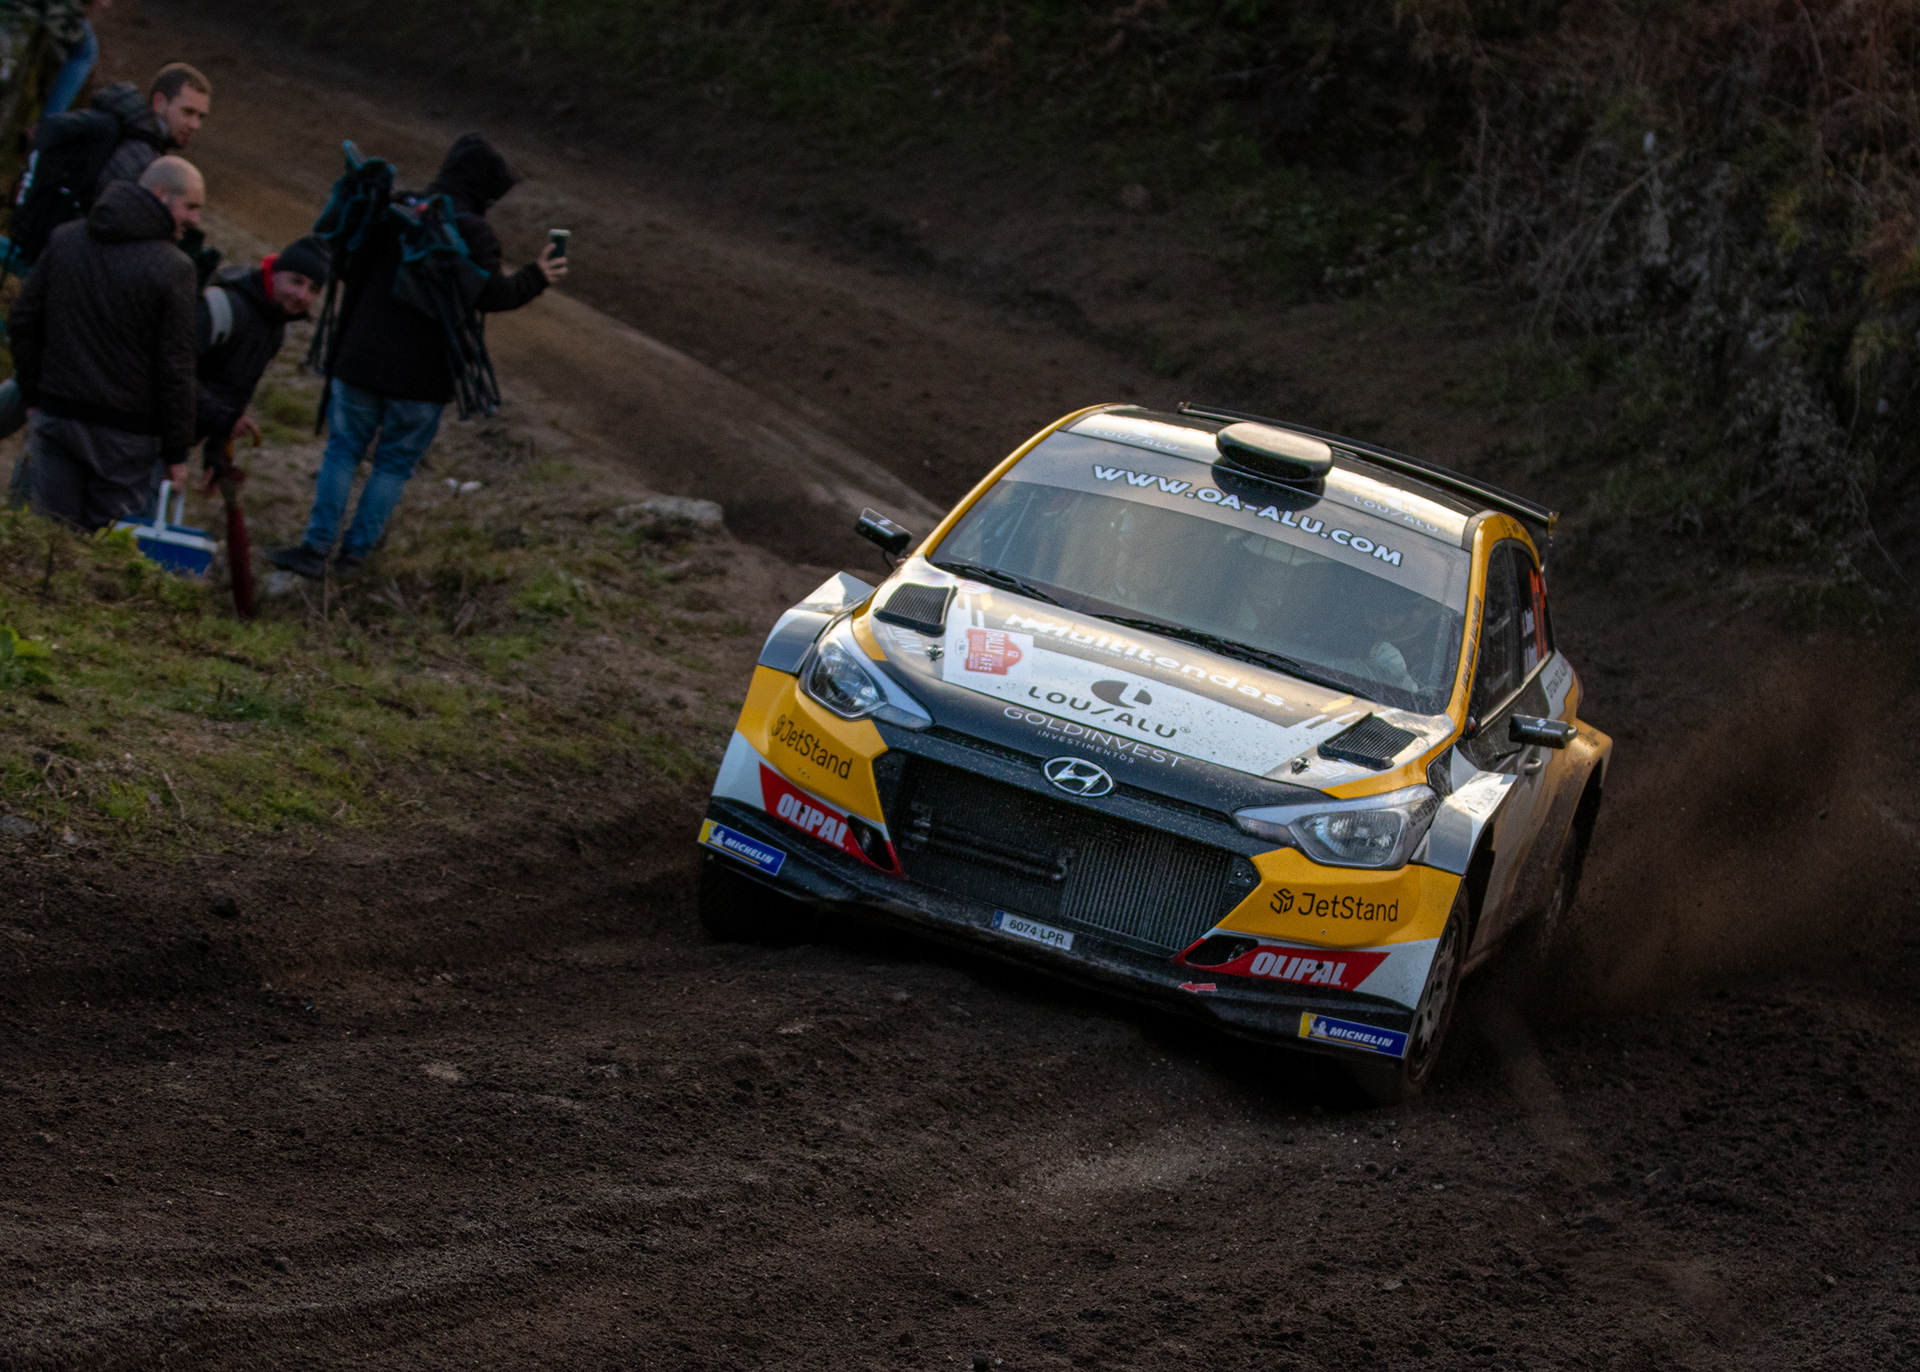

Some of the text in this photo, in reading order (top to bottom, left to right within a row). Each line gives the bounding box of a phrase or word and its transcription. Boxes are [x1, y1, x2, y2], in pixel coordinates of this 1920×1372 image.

[1092, 464, 1403, 568] WWW.OA-ALU.COM
[1353, 495, 1439, 533] LOU/ALU
[985, 631, 1004, 655] RALLY
[780, 719, 853, 780] JetStand
[1003, 706, 1185, 769] GOLDINVEST
[1037, 729, 1135, 764] INVESTIMENTOS
[776, 793, 849, 848] OLIPAL
[724, 837, 774, 865] MICHELIN
[1298, 892, 1399, 922] JetStand
[1009, 919, 1064, 944] 6074 LPR
[1249, 952, 1347, 986] OLIPAL
[1328, 1026, 1394, 1048] MICHELIN
